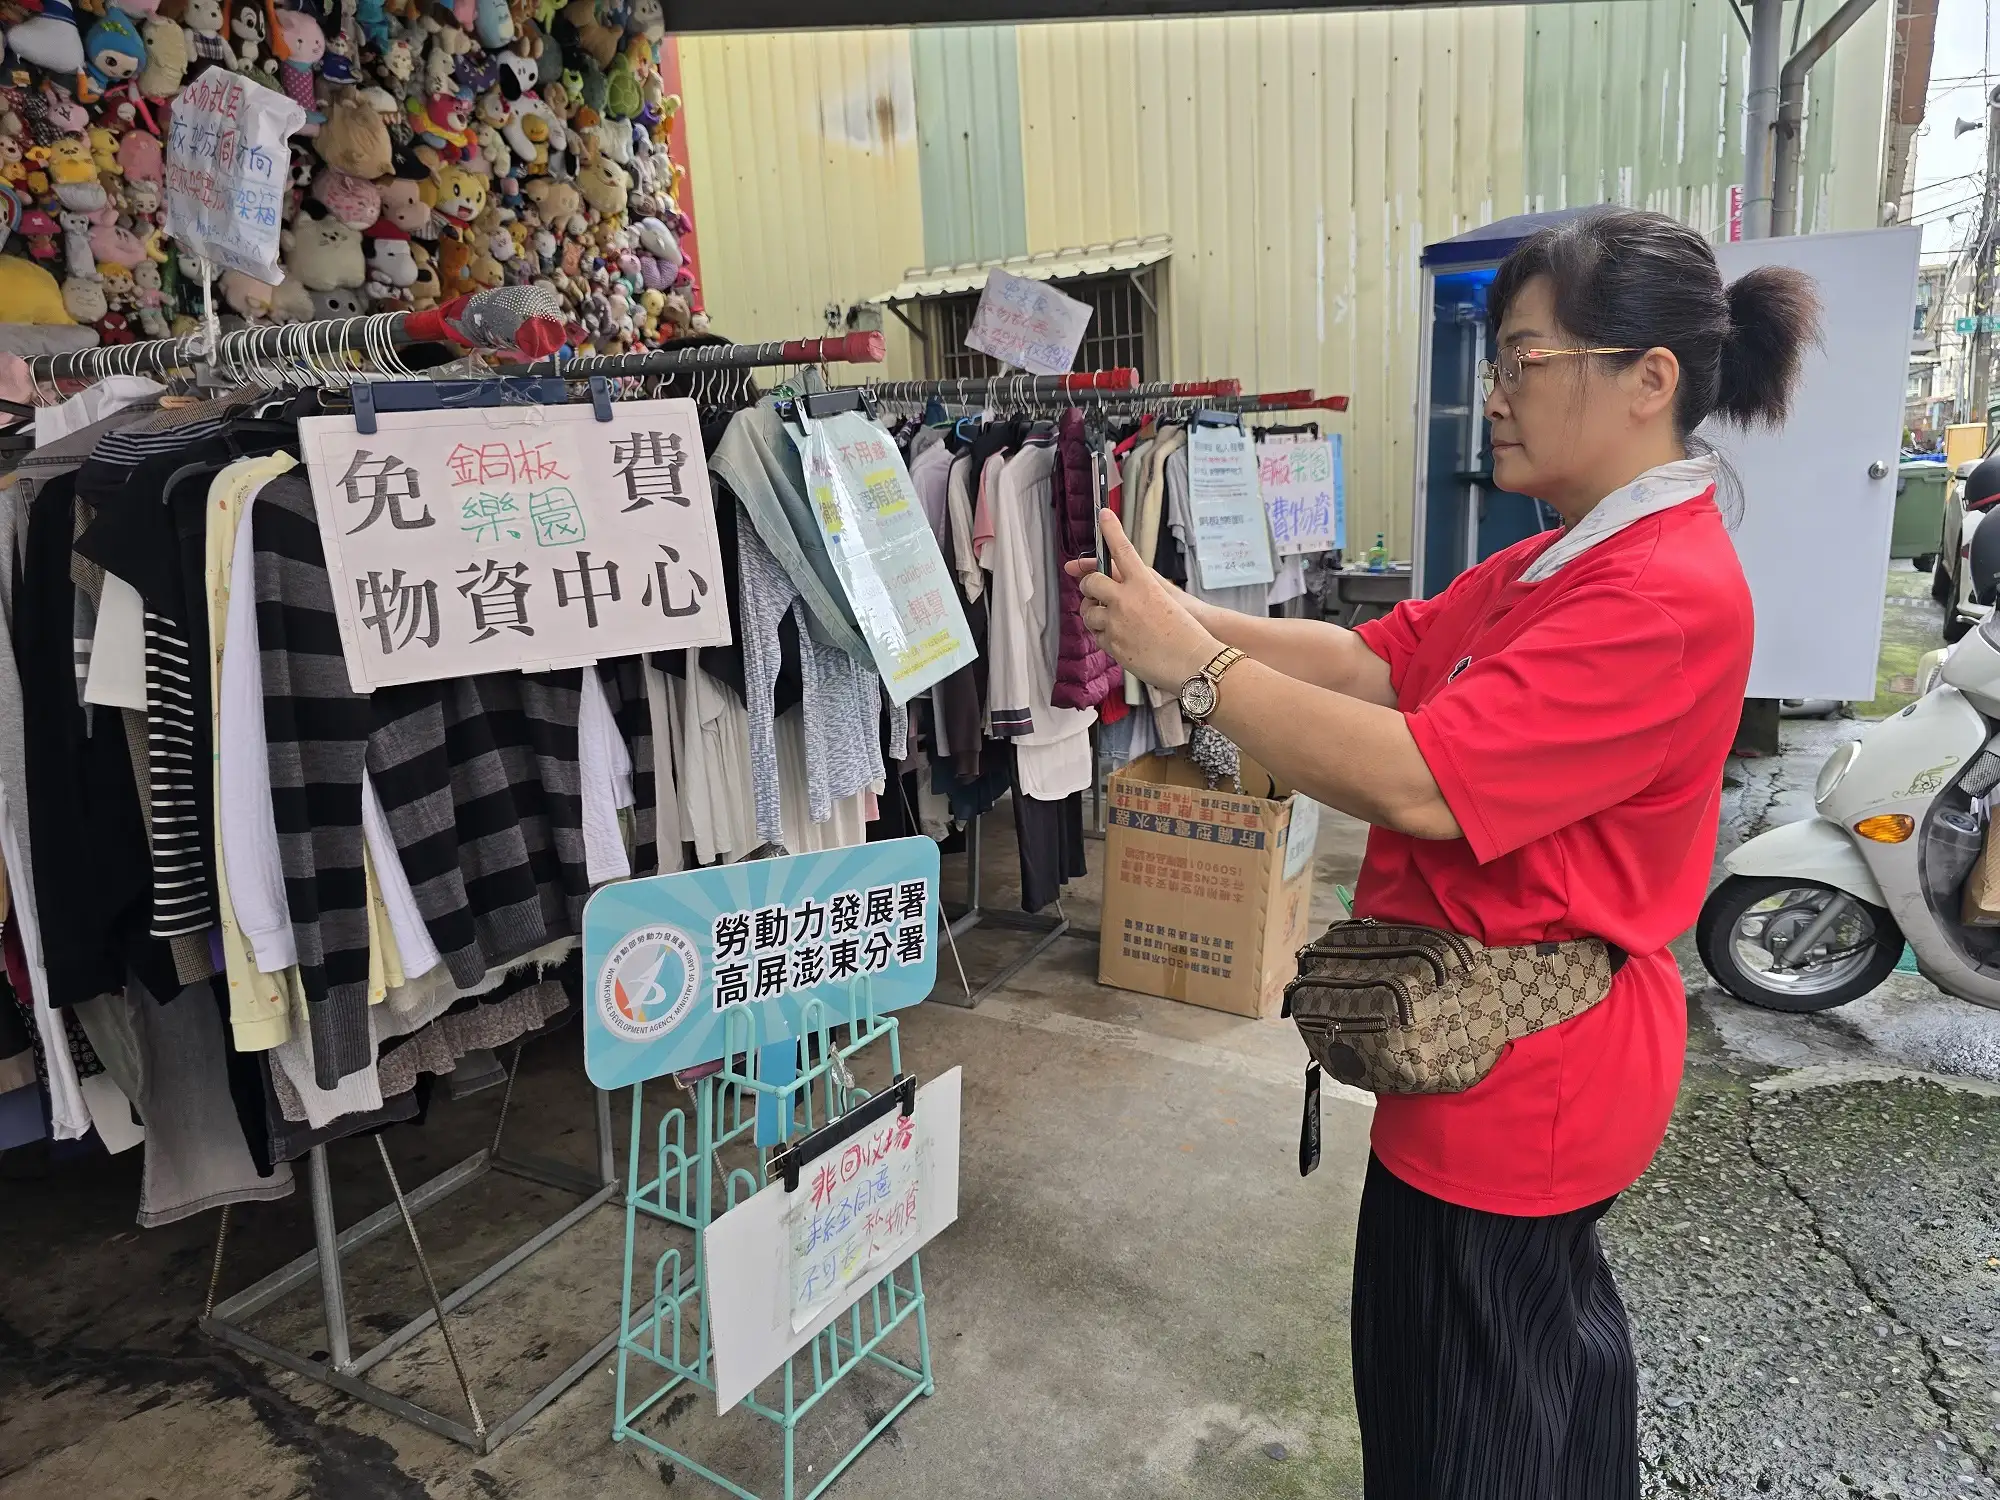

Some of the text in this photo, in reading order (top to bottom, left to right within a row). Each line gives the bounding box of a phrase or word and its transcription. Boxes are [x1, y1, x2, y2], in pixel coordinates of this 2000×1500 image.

[336, 430, 692, 536] 免 費
[445, 439, 571, 486] 銅板
[460, 486, 587, 547] 樂園
[355, 544, 708, 656] 物資中心
[714, 880, 927, 960] 勞動力發展署
[613, 931, 686, 965] 勞動部勞動力發展署
[683, 949, 696, 973] LABOR
[714, 922, 926, 1010] 高屏澎東分署
[603, 967, 616, 1012] WORKFORCE
[674, 984, 694, 1016] MINISTRY
[688, 973, 696, 983] OF
[608, 1009, 649, 1035] DEVELOPMENT
